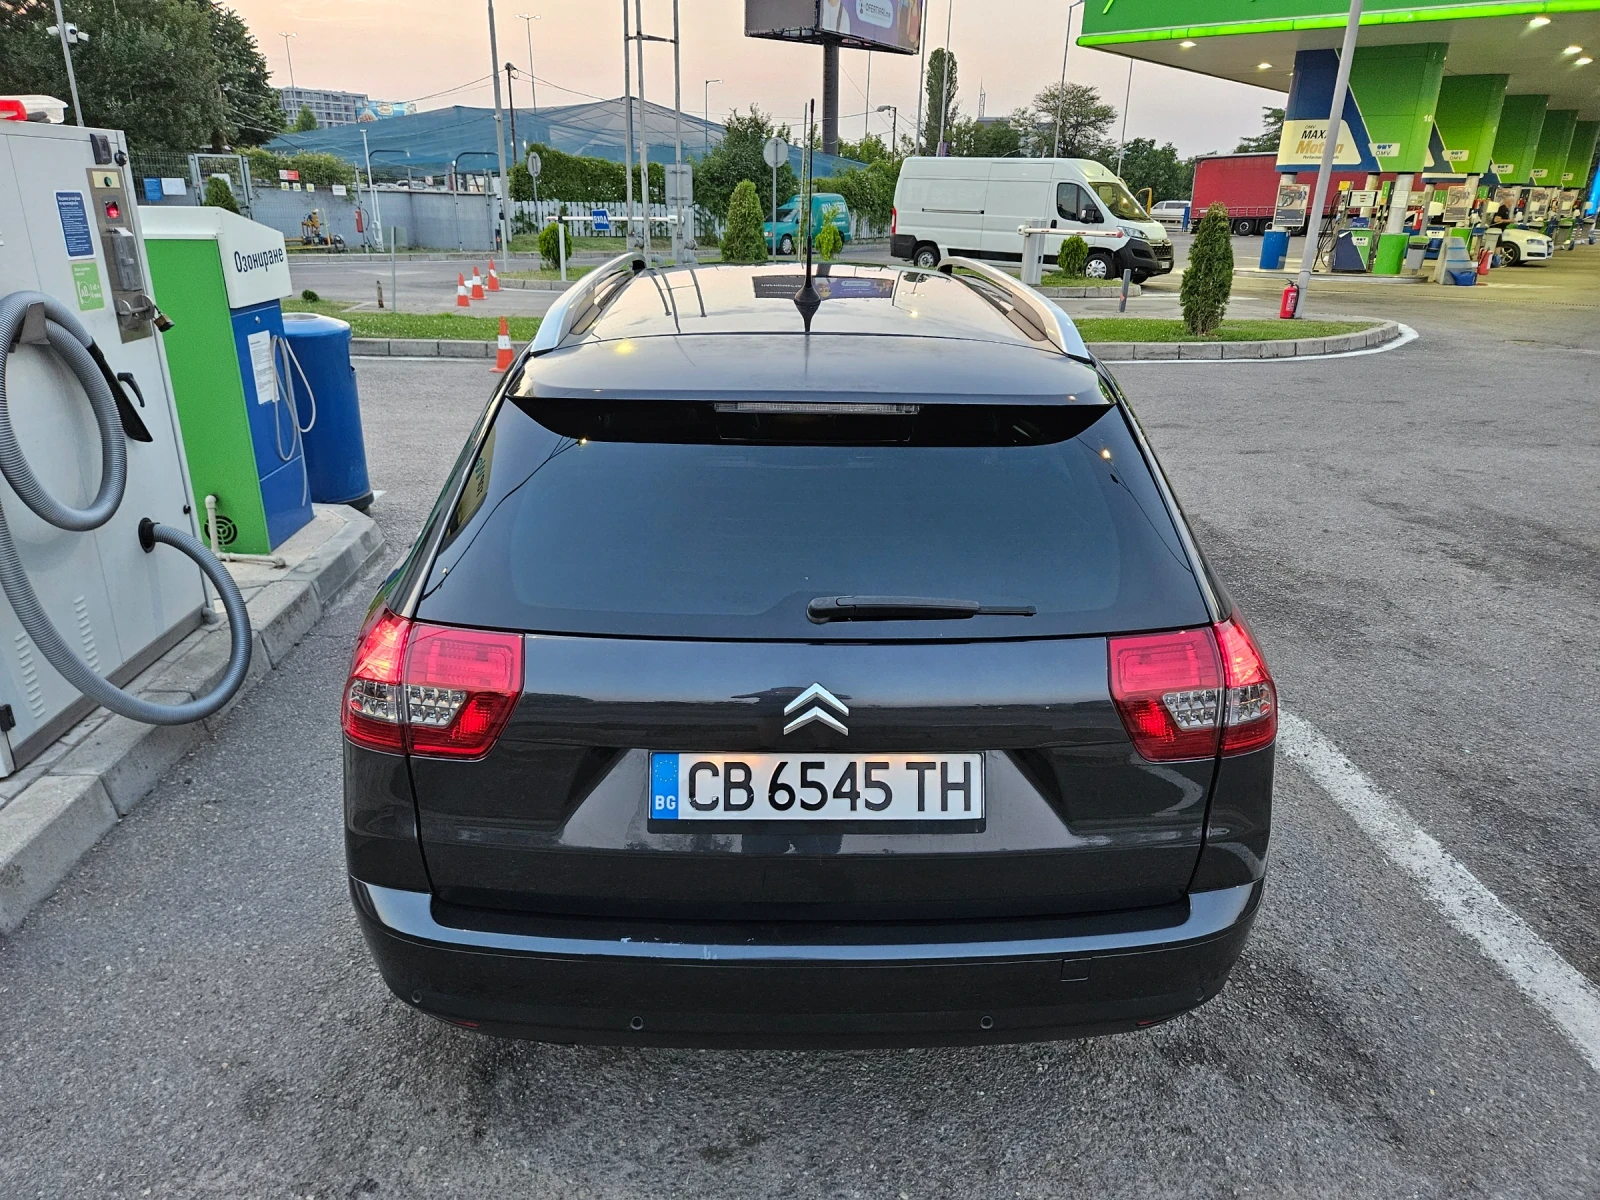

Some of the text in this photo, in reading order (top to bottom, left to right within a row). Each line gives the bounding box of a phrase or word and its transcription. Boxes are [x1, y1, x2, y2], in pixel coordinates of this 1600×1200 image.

[1301, 130, 1327, 139] MAX
[1295, 140, 1344, 154] Motn
[593, 215, 609, 224] ВХОД
[234, 248, 284, 272] Озониране
[689, 761, 971, 811] CB 6545 TH
[655, 795, 676, 810] BG
